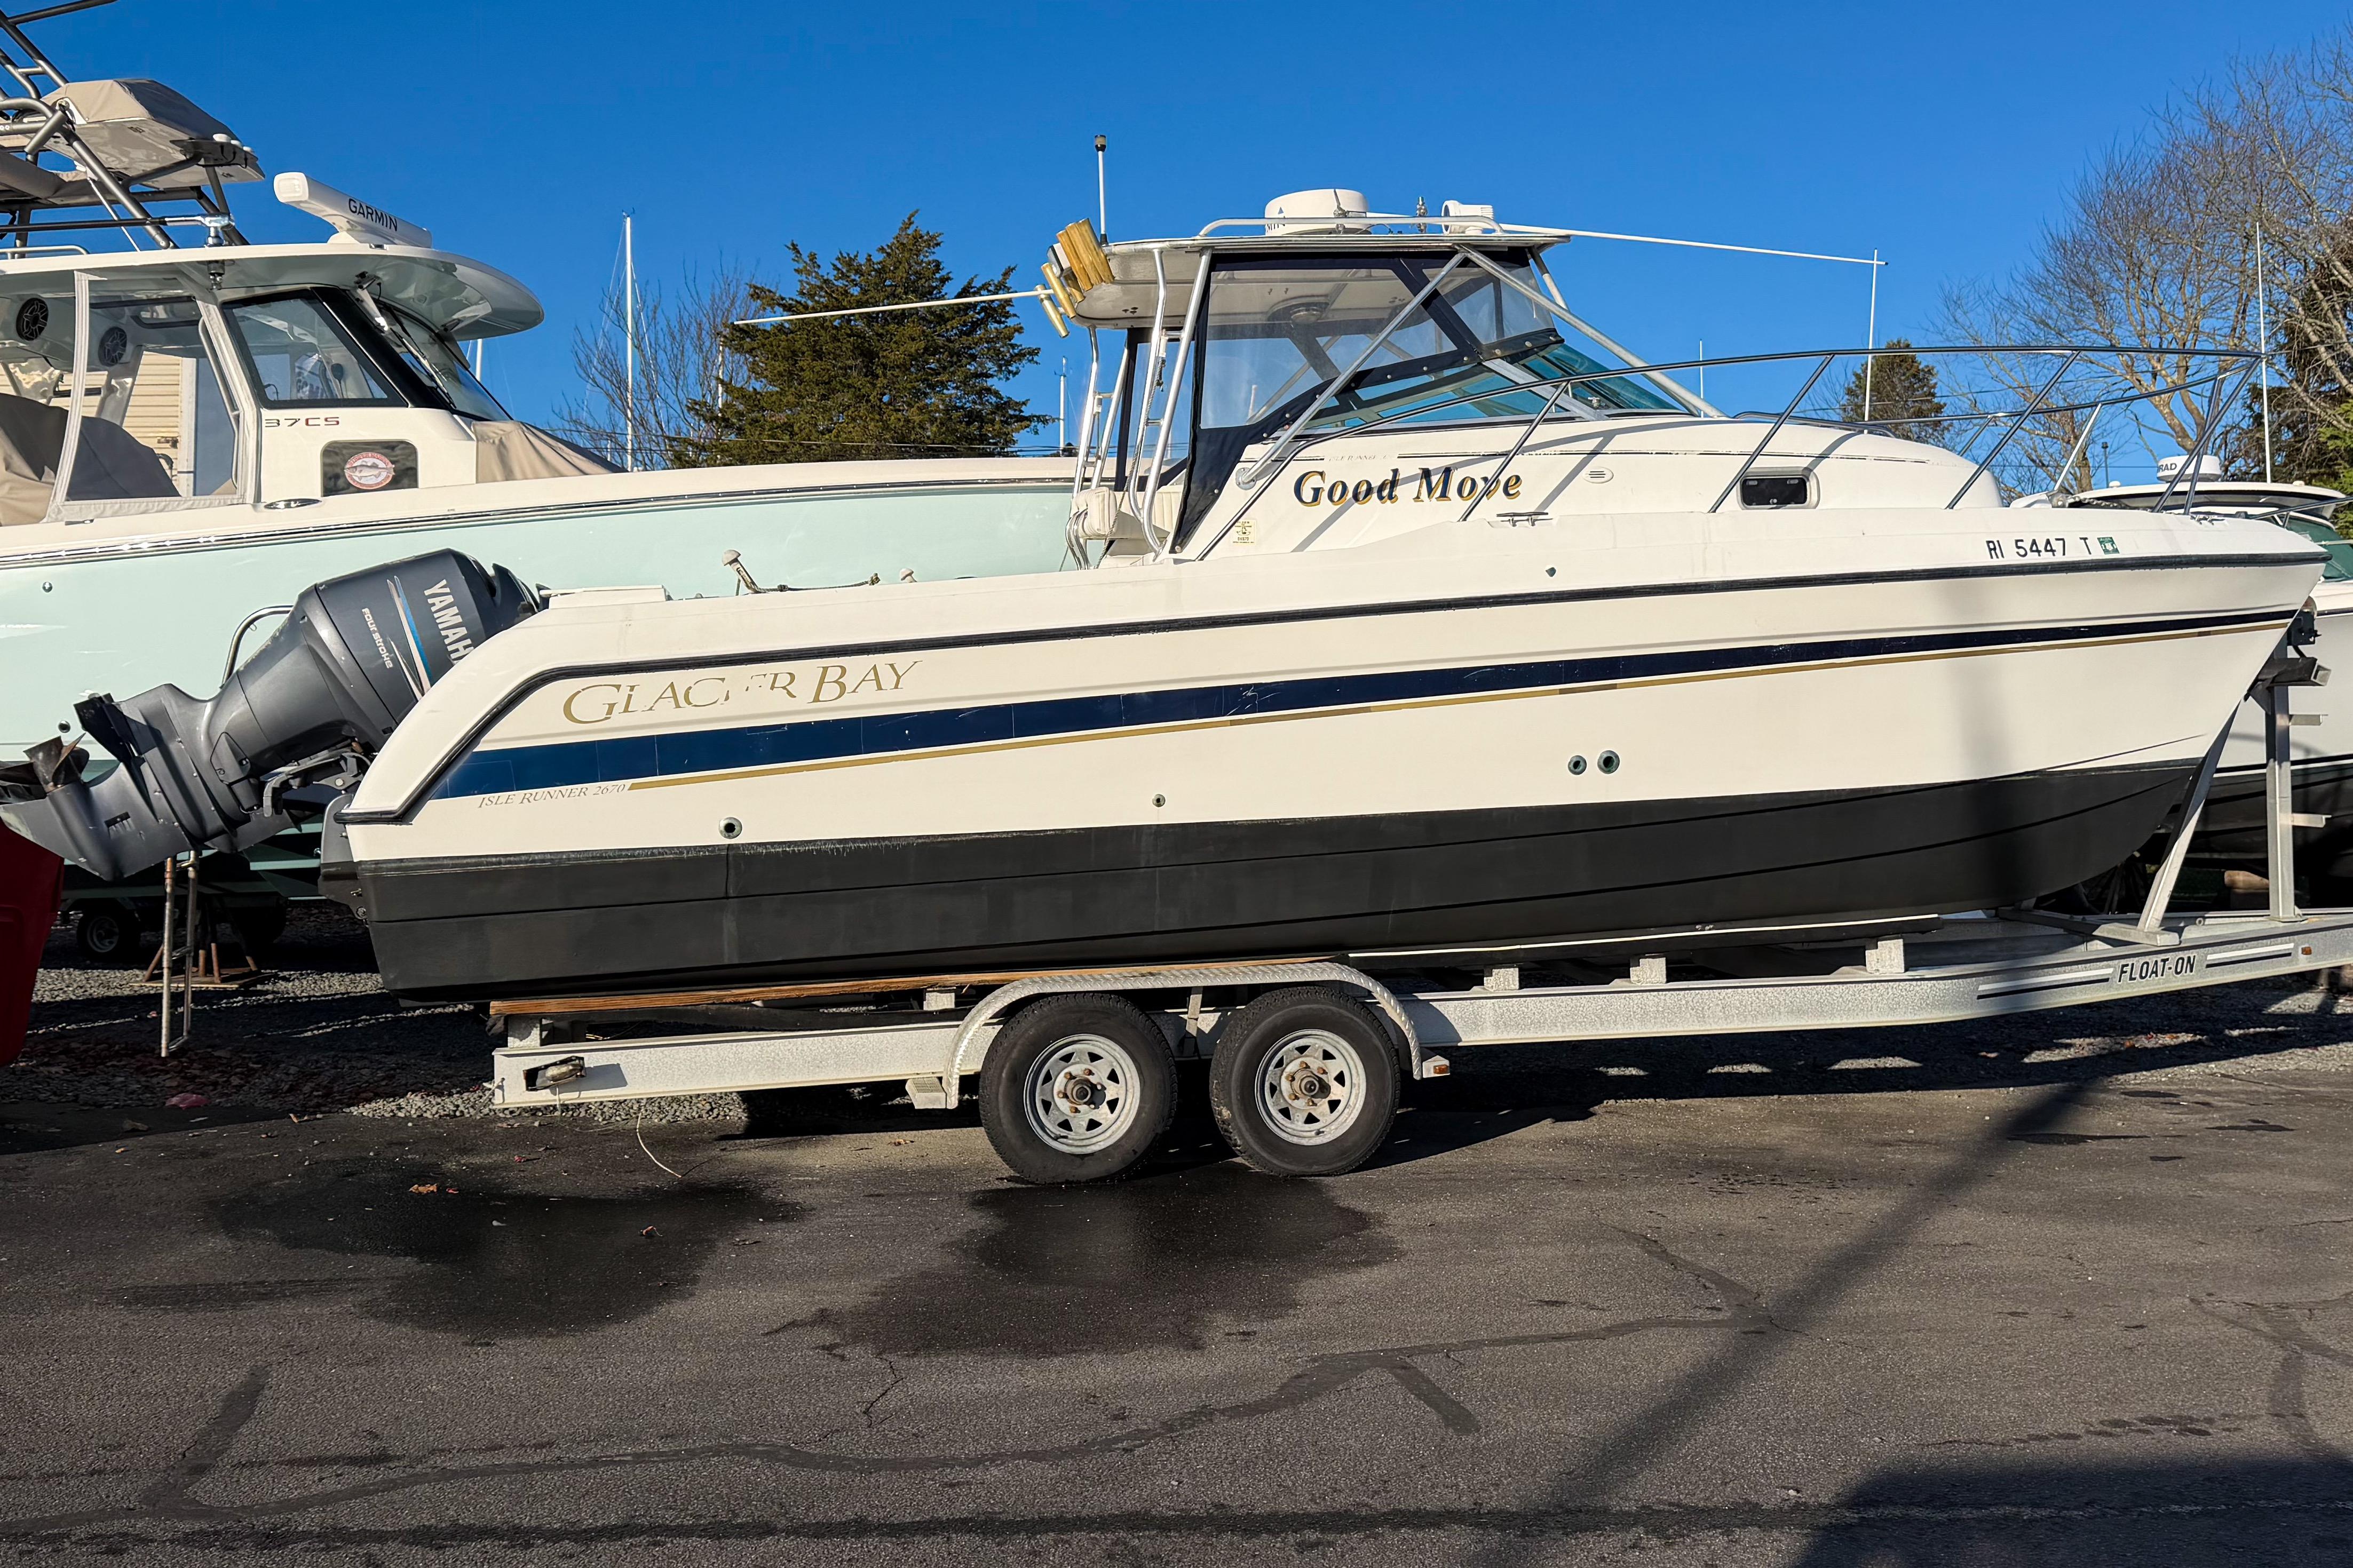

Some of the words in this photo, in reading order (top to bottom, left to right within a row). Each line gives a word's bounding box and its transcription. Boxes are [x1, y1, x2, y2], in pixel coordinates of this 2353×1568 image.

[348, 198, 398, 232] GARMIN
[265, 417, 339, 427] 37CS
[1294, 468, 1400, 507] Good
[1985, 540, 2005, 559] RI
[2015, 538, 2065, 557] 5447
[2079, 537, 2091, 555] T
[424, 579, 474, 665] YAMAH
[806, 660, 923, 704] BAY
[478, 794, 515, 808] ISLE
[519, 787, 588, 805] RUNNER
[592, 784, 625, 795] 2670
[2118, 955, 2196, 983] FLOAT-ON
